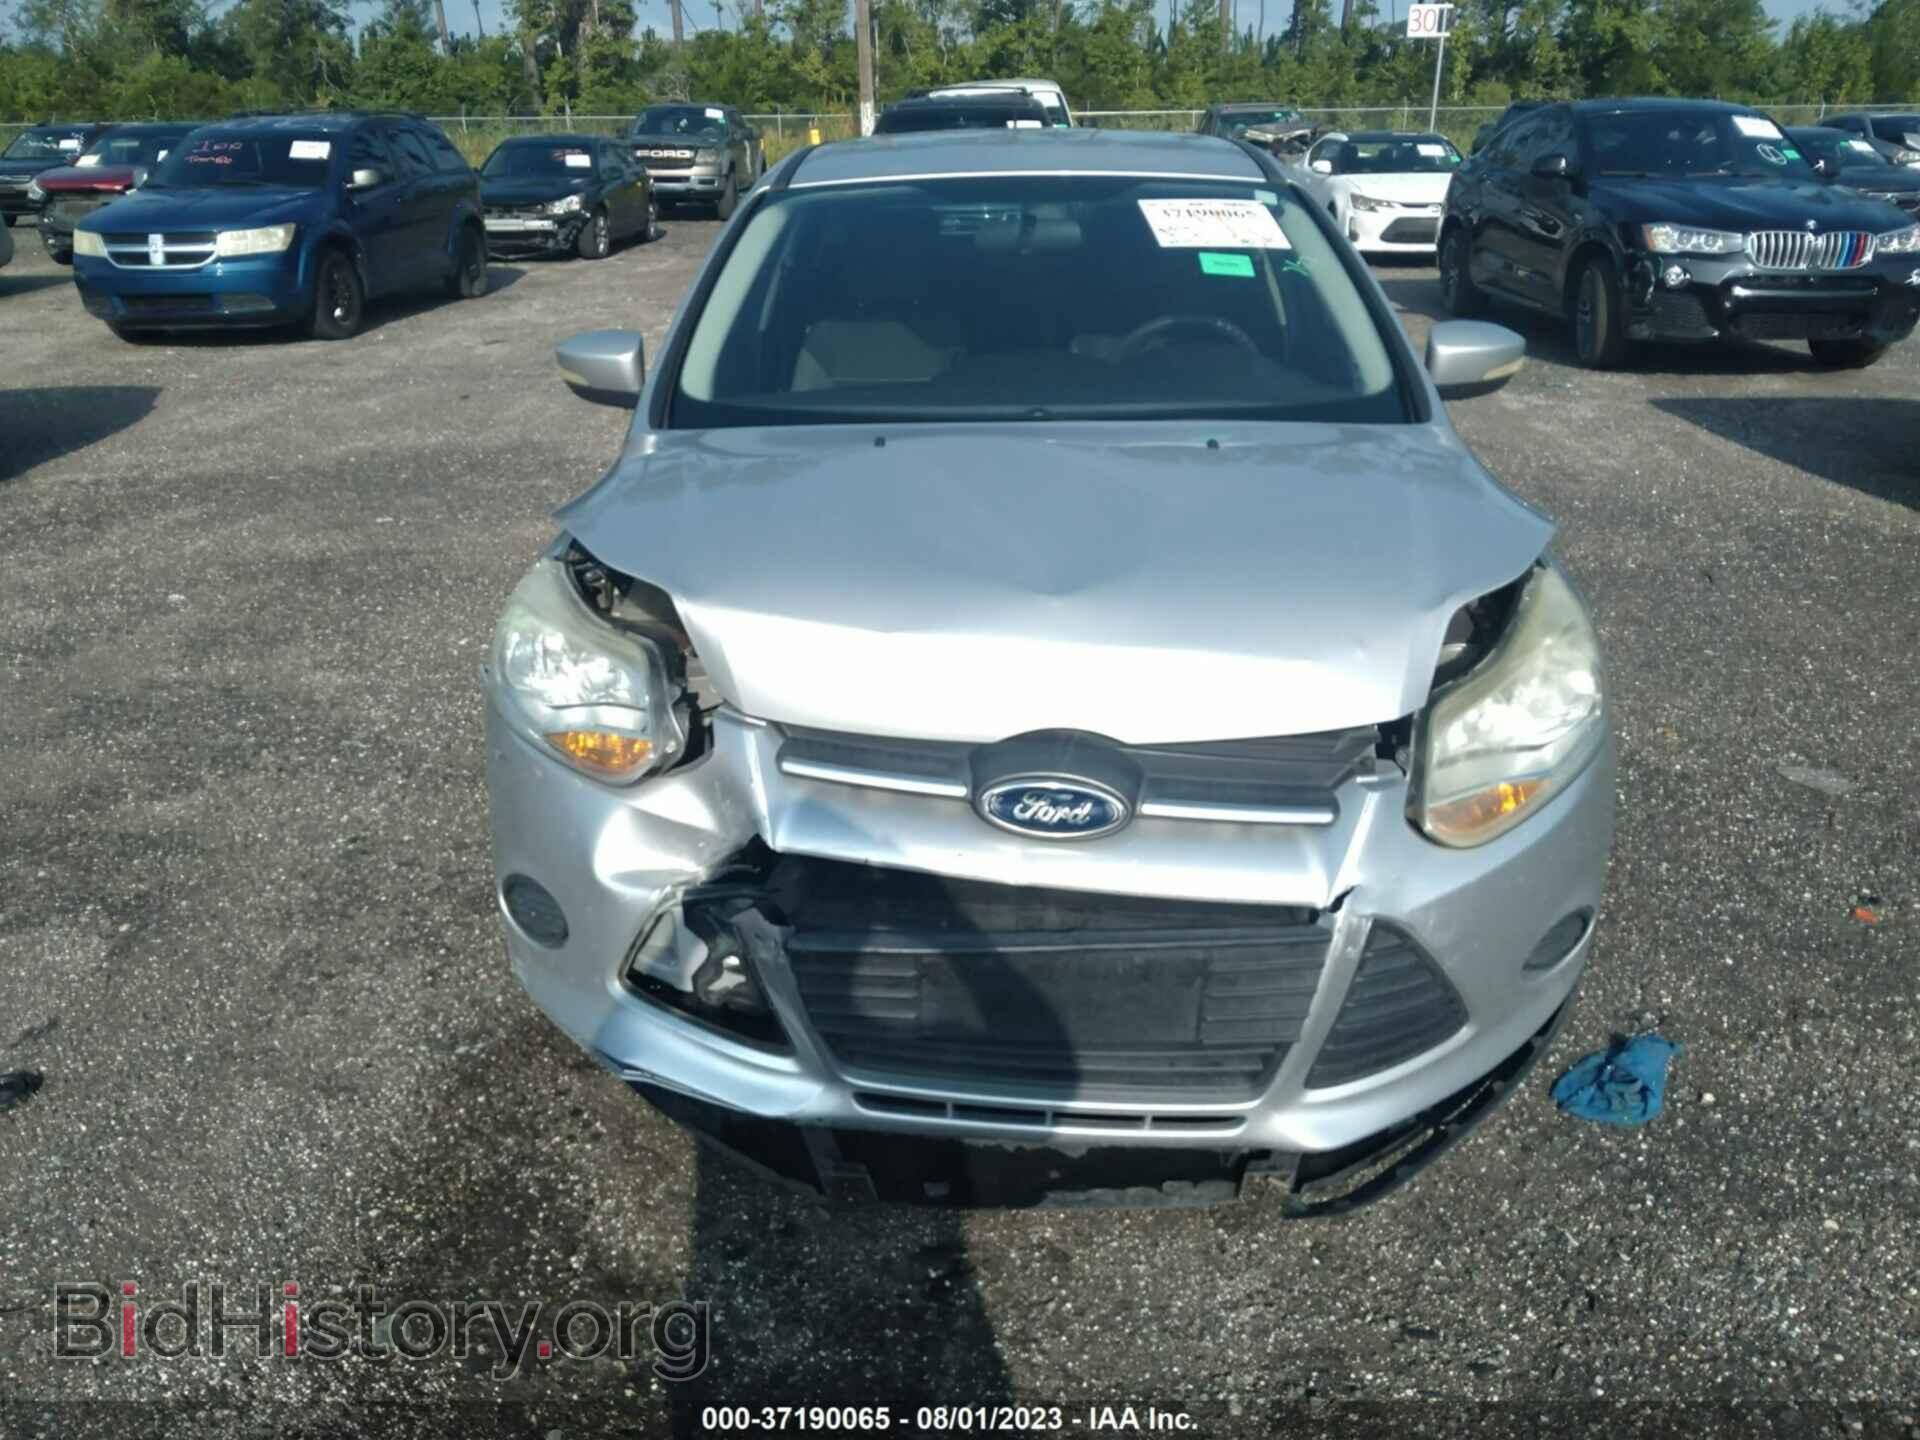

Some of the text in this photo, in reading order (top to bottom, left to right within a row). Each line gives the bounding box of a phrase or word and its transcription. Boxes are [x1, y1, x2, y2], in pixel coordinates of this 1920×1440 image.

[1409, 8, 1437, 32] 30
[635, 149, 695, 159] FORD
[1013, 791, 1093, 824] Ford
